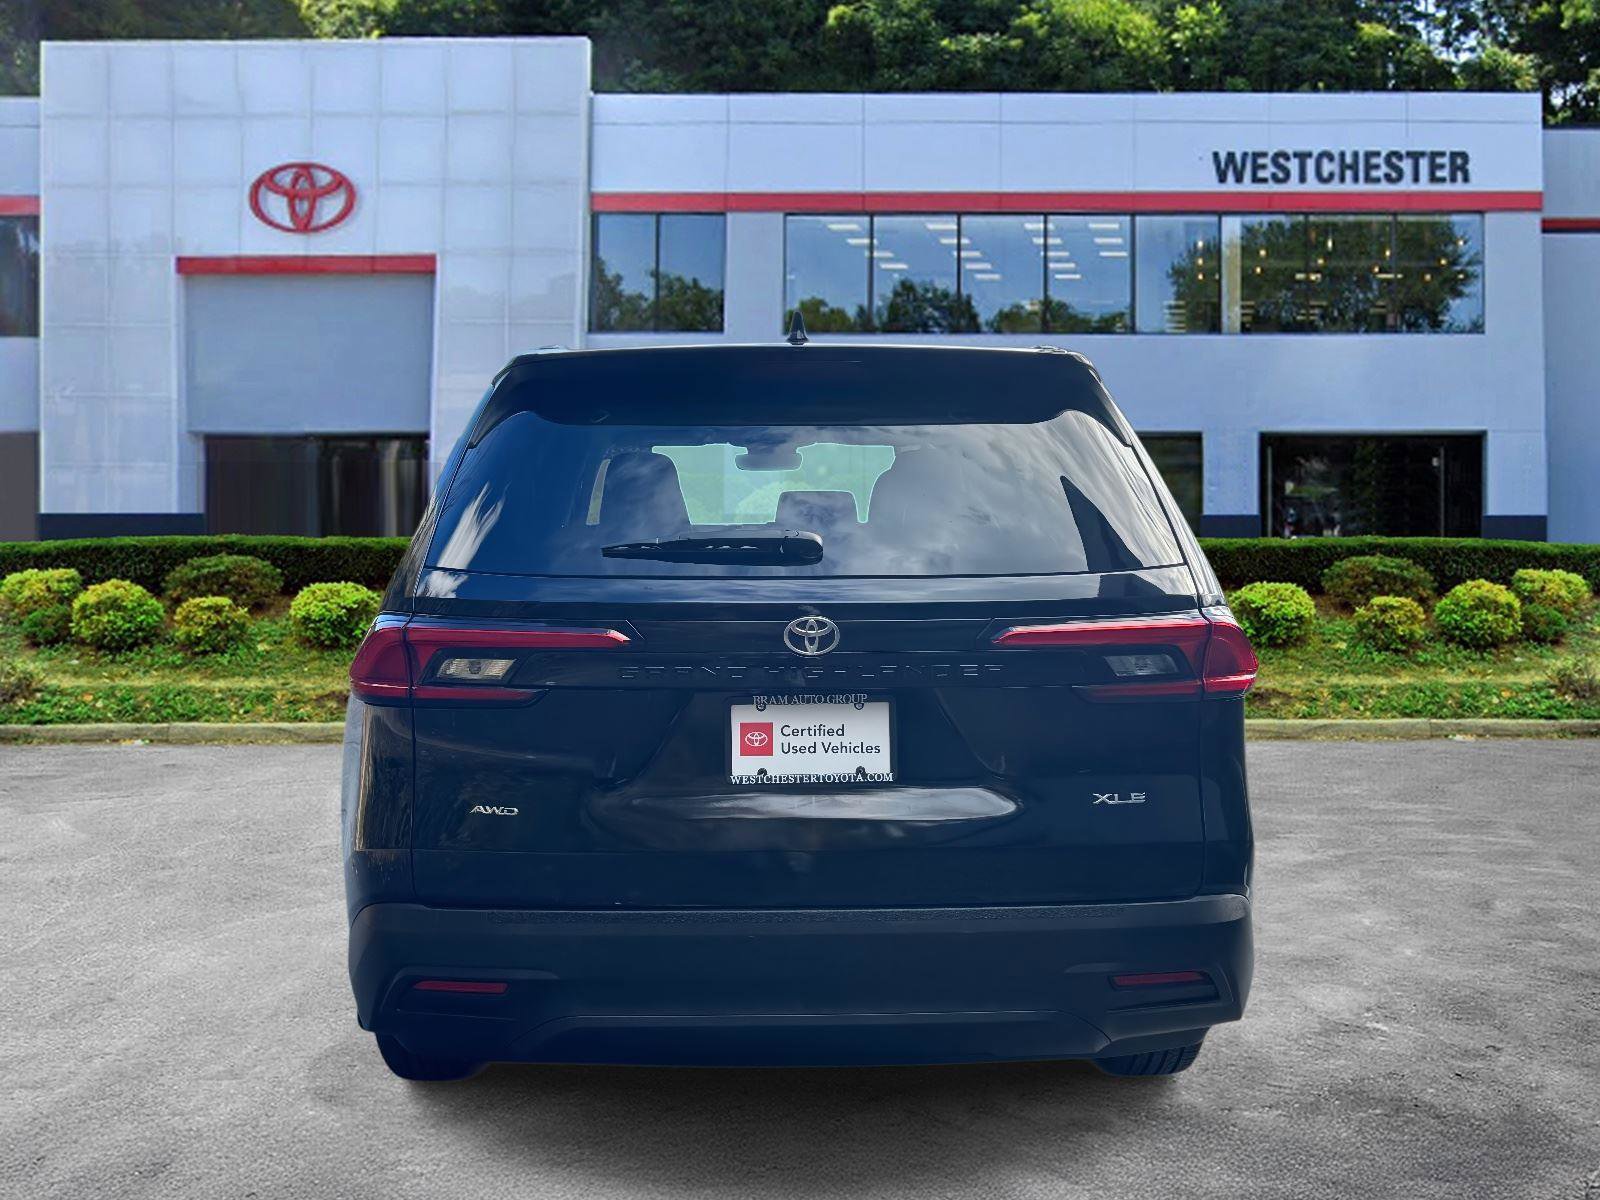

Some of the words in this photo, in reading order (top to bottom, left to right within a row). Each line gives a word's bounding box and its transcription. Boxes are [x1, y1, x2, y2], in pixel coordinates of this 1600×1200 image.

[1212, 150, 1471, 184] WESTCHESTER
[753, 695, 790, 706] BRAM
[792, 694, 824, 705] AUTO
[826, 693, 868, 705] GROUP
[780, 724, 845, 737] Certified
[780, 742, 817, 754] Used
[821, 741, 881, 754] Vehicles
[730, 773, 894, 785] WESTCHESTERTOYOTA.COM
[1092, 792, 1146, 804] XLE
[469, 805, 519, 816] AWD
